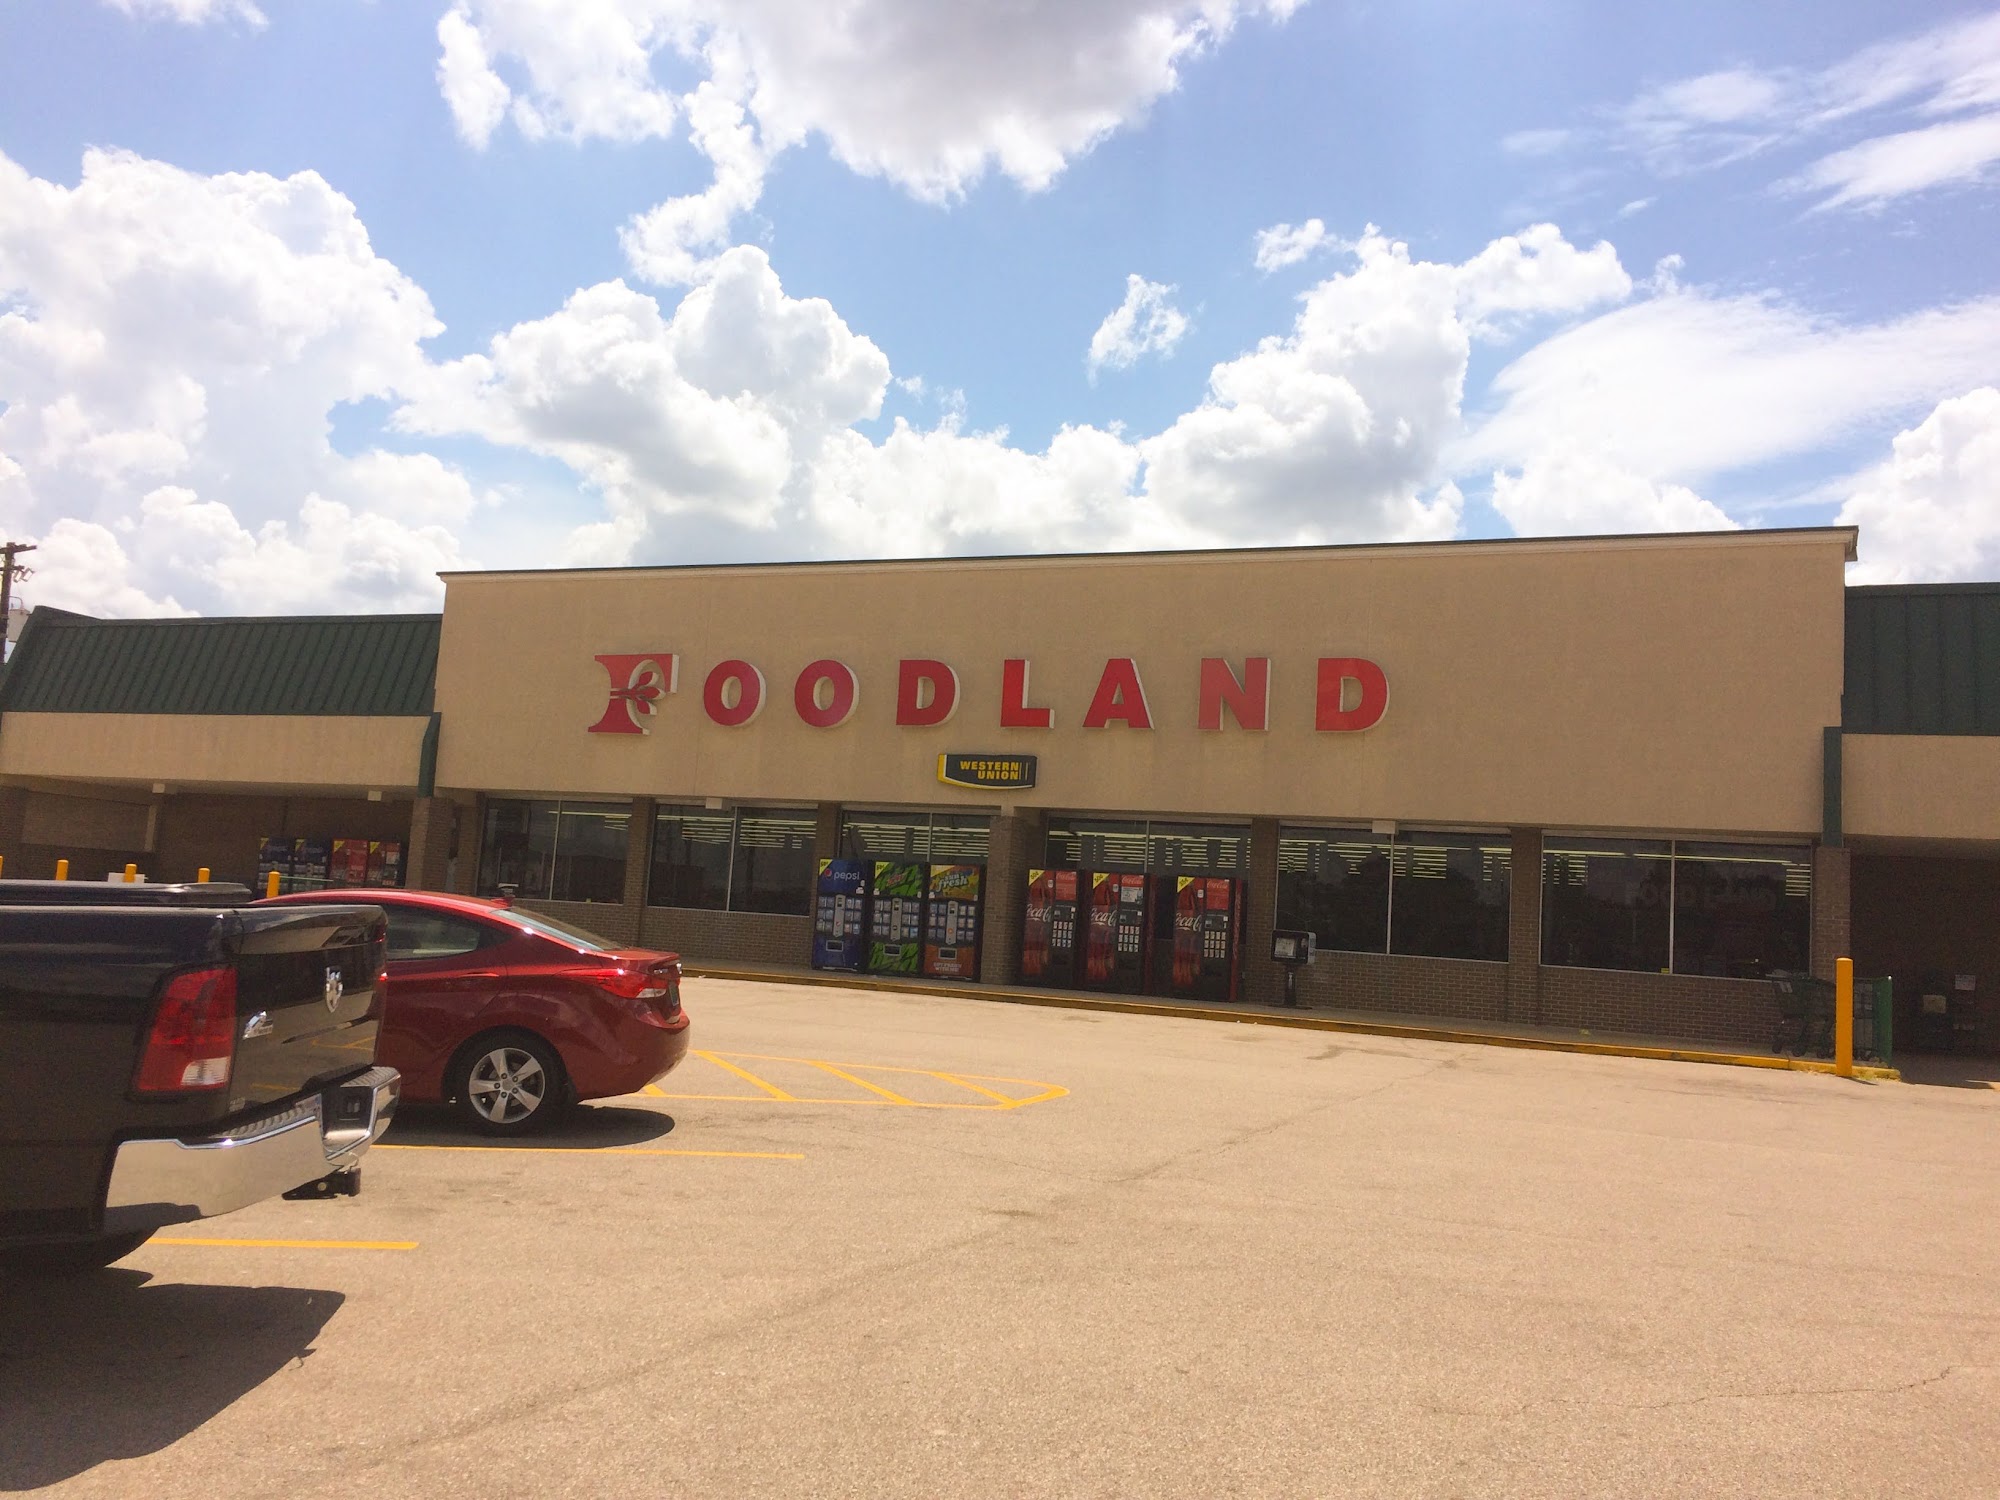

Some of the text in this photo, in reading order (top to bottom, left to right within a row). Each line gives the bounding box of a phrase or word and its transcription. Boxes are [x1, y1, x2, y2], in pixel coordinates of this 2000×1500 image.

[588, 653, 1391, 735] FOODLAND
[959, 760, 1019, 771] WESTERN
[977, 770, 1019, 780] UNION
[834, 872, 860, 881] pepsi
[936, 876, 968, 893] fresh
